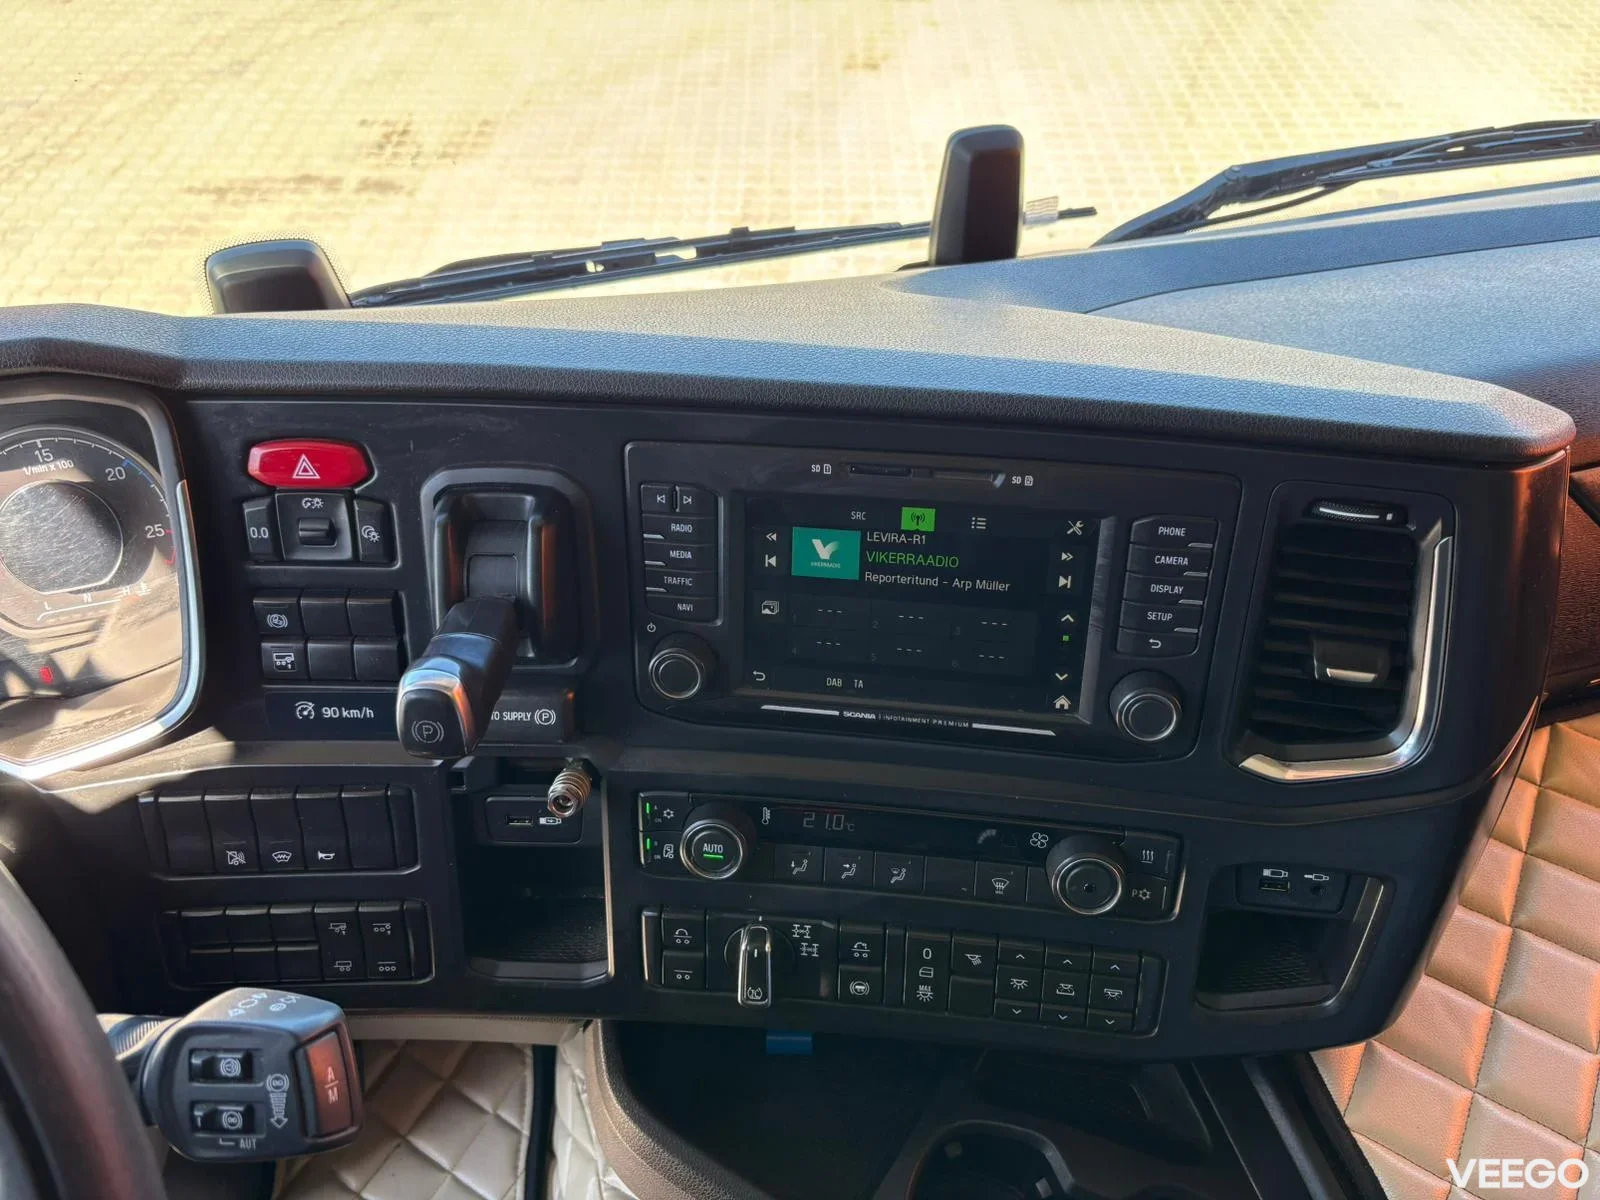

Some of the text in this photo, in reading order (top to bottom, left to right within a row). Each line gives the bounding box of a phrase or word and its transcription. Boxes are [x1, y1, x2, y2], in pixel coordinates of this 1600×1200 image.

[34, 448, 54, 463] 15
[22, 465, 49, 477] 1/min
[57, 459, 75, 470] 100
[105, 466, 126, 482] 20
[811, 464, 821, 473] SD
[1012, 475, 1022, 485] SD
[851, 510, 867, 521] SRC
[144, 523, 166, 539] 25
[670, 522, 693, 534] RADIO
[1157, 525, 1187, 537] PHONE
[866, 531, 927, 545] LEVIRA-R1
[669, 549, 692, 560] MEDIA
[866, 551, 960, 568] VIKERRAADIO
[1154, 555, 1189, 567] CAMERA
[663, 575, 693, 587] TRAFFIC
[864, 571, 939, 587] Reporteritund
[952, 578, 973, 591] Arp
[975, 579, 1011, 592] Müller
[1150, 583, 1184, 595] DISPLAY
[676, 602, 694, 613] NAVI
[1147, 611, 1173, 622] SETUP
[826, 677, 864, 689] DAB TA
[321, 706, 375, 719] 90 km/h
[502, 711, 531, 722] SUPPLY
[843, 710, 876, 720] SCANIA
[932, 718, 969, 728] PREMIUM
[702, 842, 724, 854] AUTO
